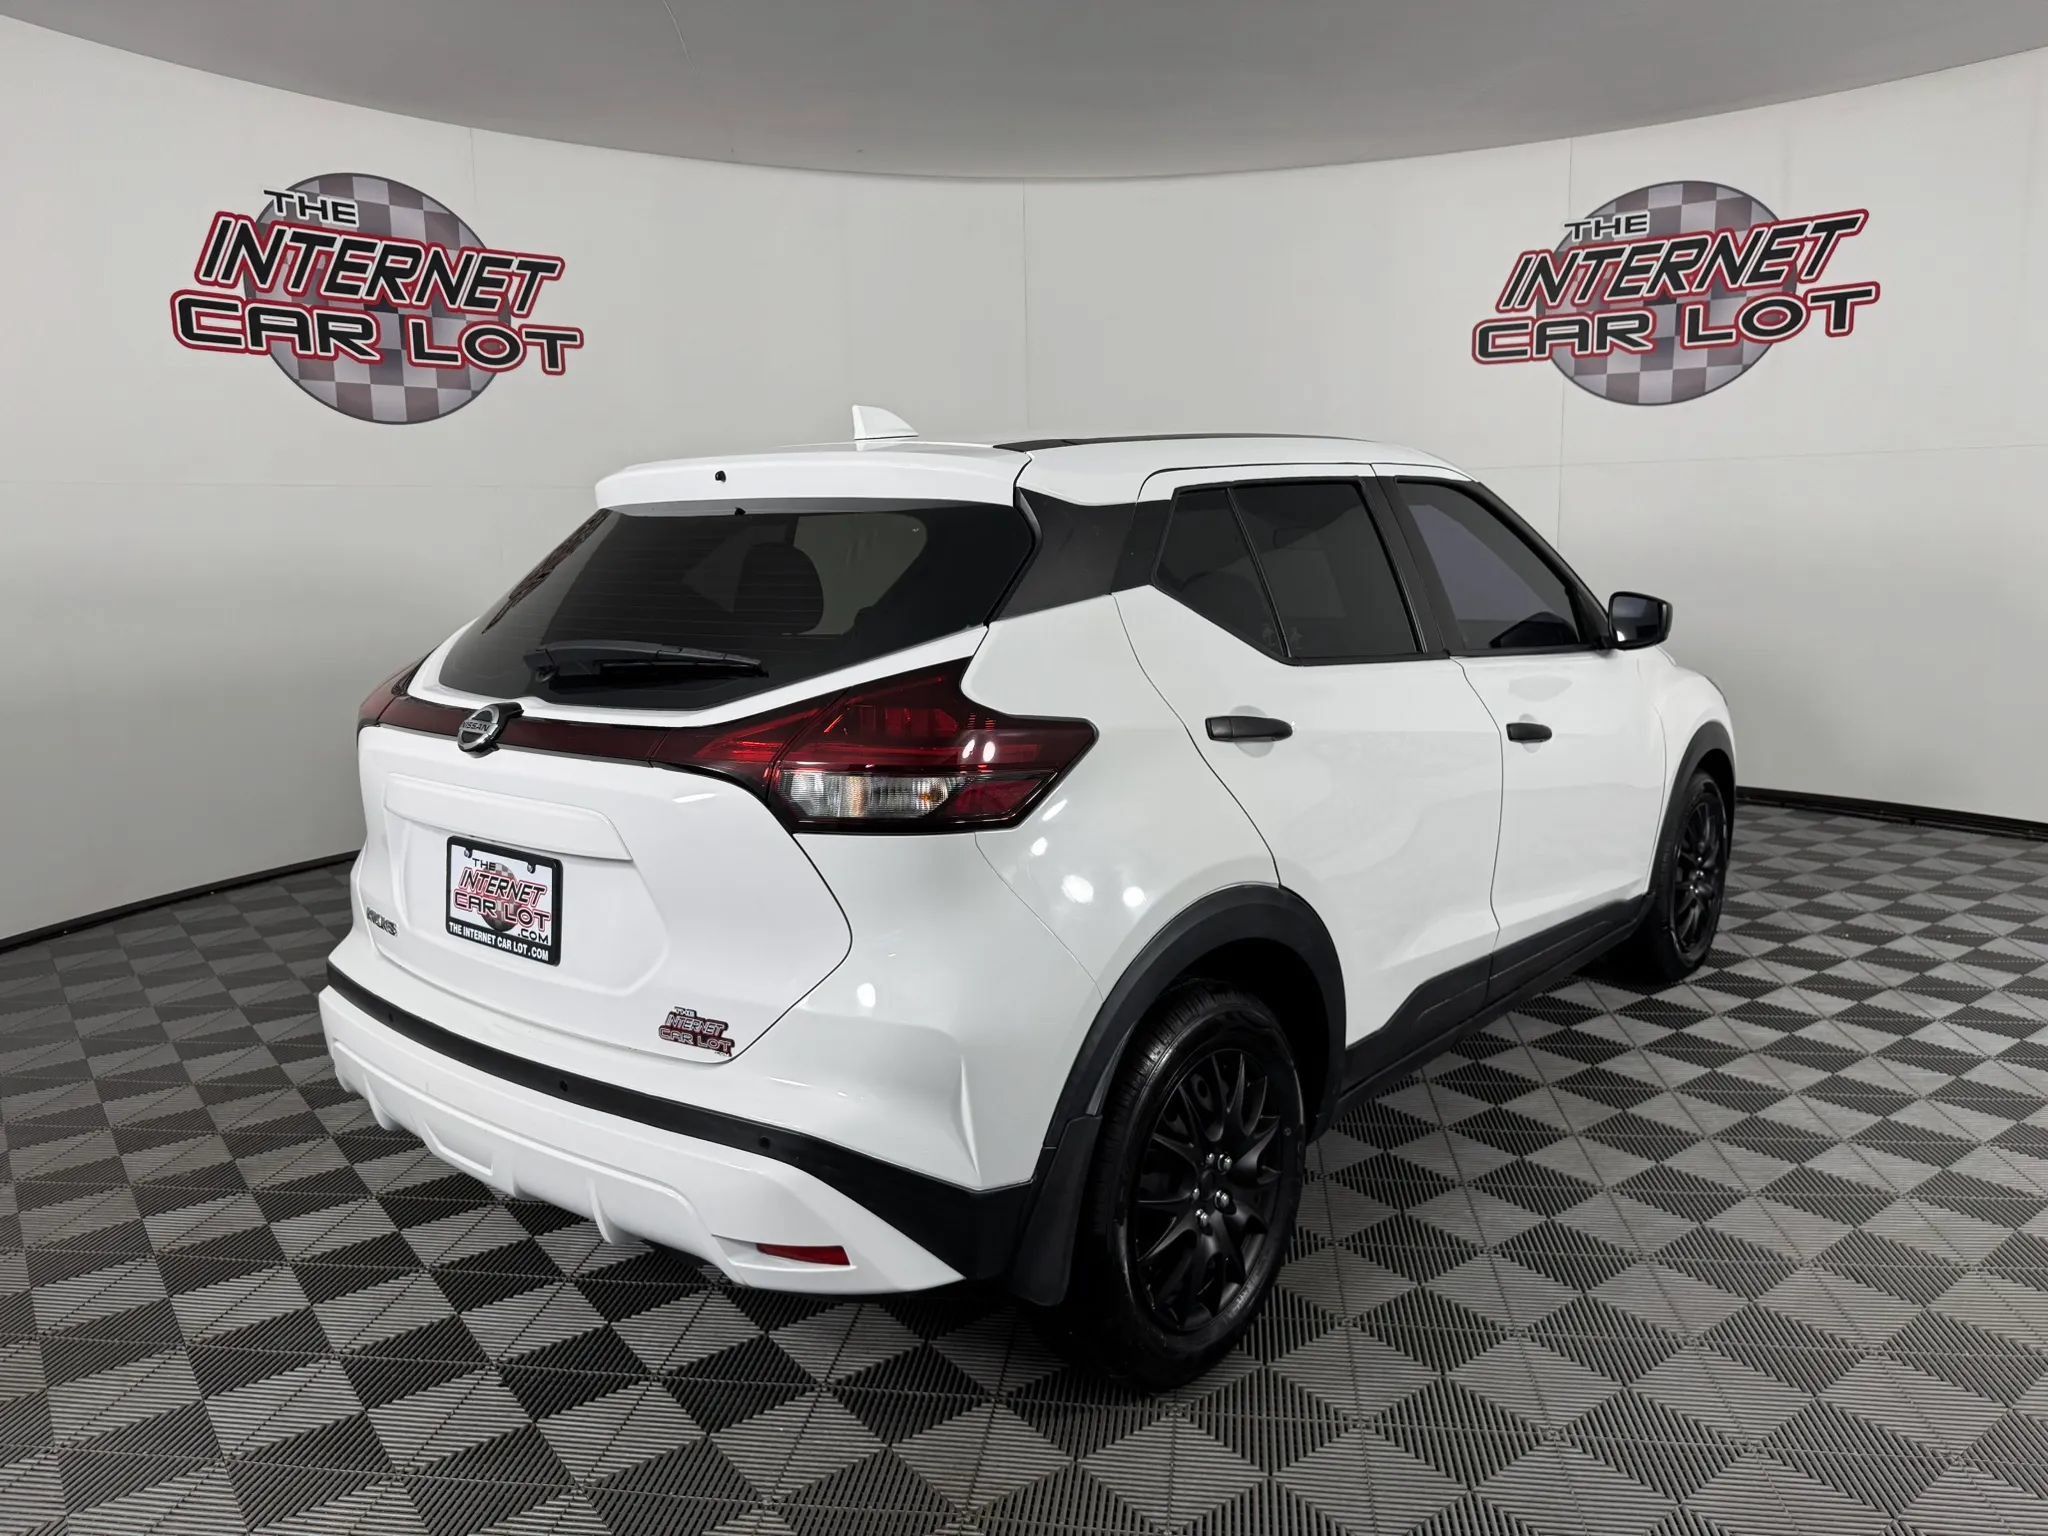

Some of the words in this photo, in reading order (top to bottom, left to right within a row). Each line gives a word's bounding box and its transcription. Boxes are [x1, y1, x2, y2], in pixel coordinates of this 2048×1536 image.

[262, 188, 359, 227] THE
[1564, 212, 1649, 240] THE
[196, 213, 564, 317] INTERNET
[1497, 210, 1868, 311] INTERNET
[172, 291, 382, 363] CAR
[406, 316, 583, 374] LOT
[1473, 307, 1656, 363] CAR
[1680, 283, 1879, 347] LOT
[463, 721, 490, 731] NISSAN
[472, 858, 496, 871] THE
[459, 868, 547, 906] INTERNET
[454, 890, 497, 917] CAR
[504, 902, 550, 931] LOT
[449, 922, 462, 934] THE
[463, 926, 496, 945] INTERNET
[497, 937, 511, 950] CAR
[518, 928, 548, 944] .COM
[660, 1027, 694, 1044] CAR
[697, 1036, 732, 1051] LOT
[666, 1014, 725, 1037] INTERNET
